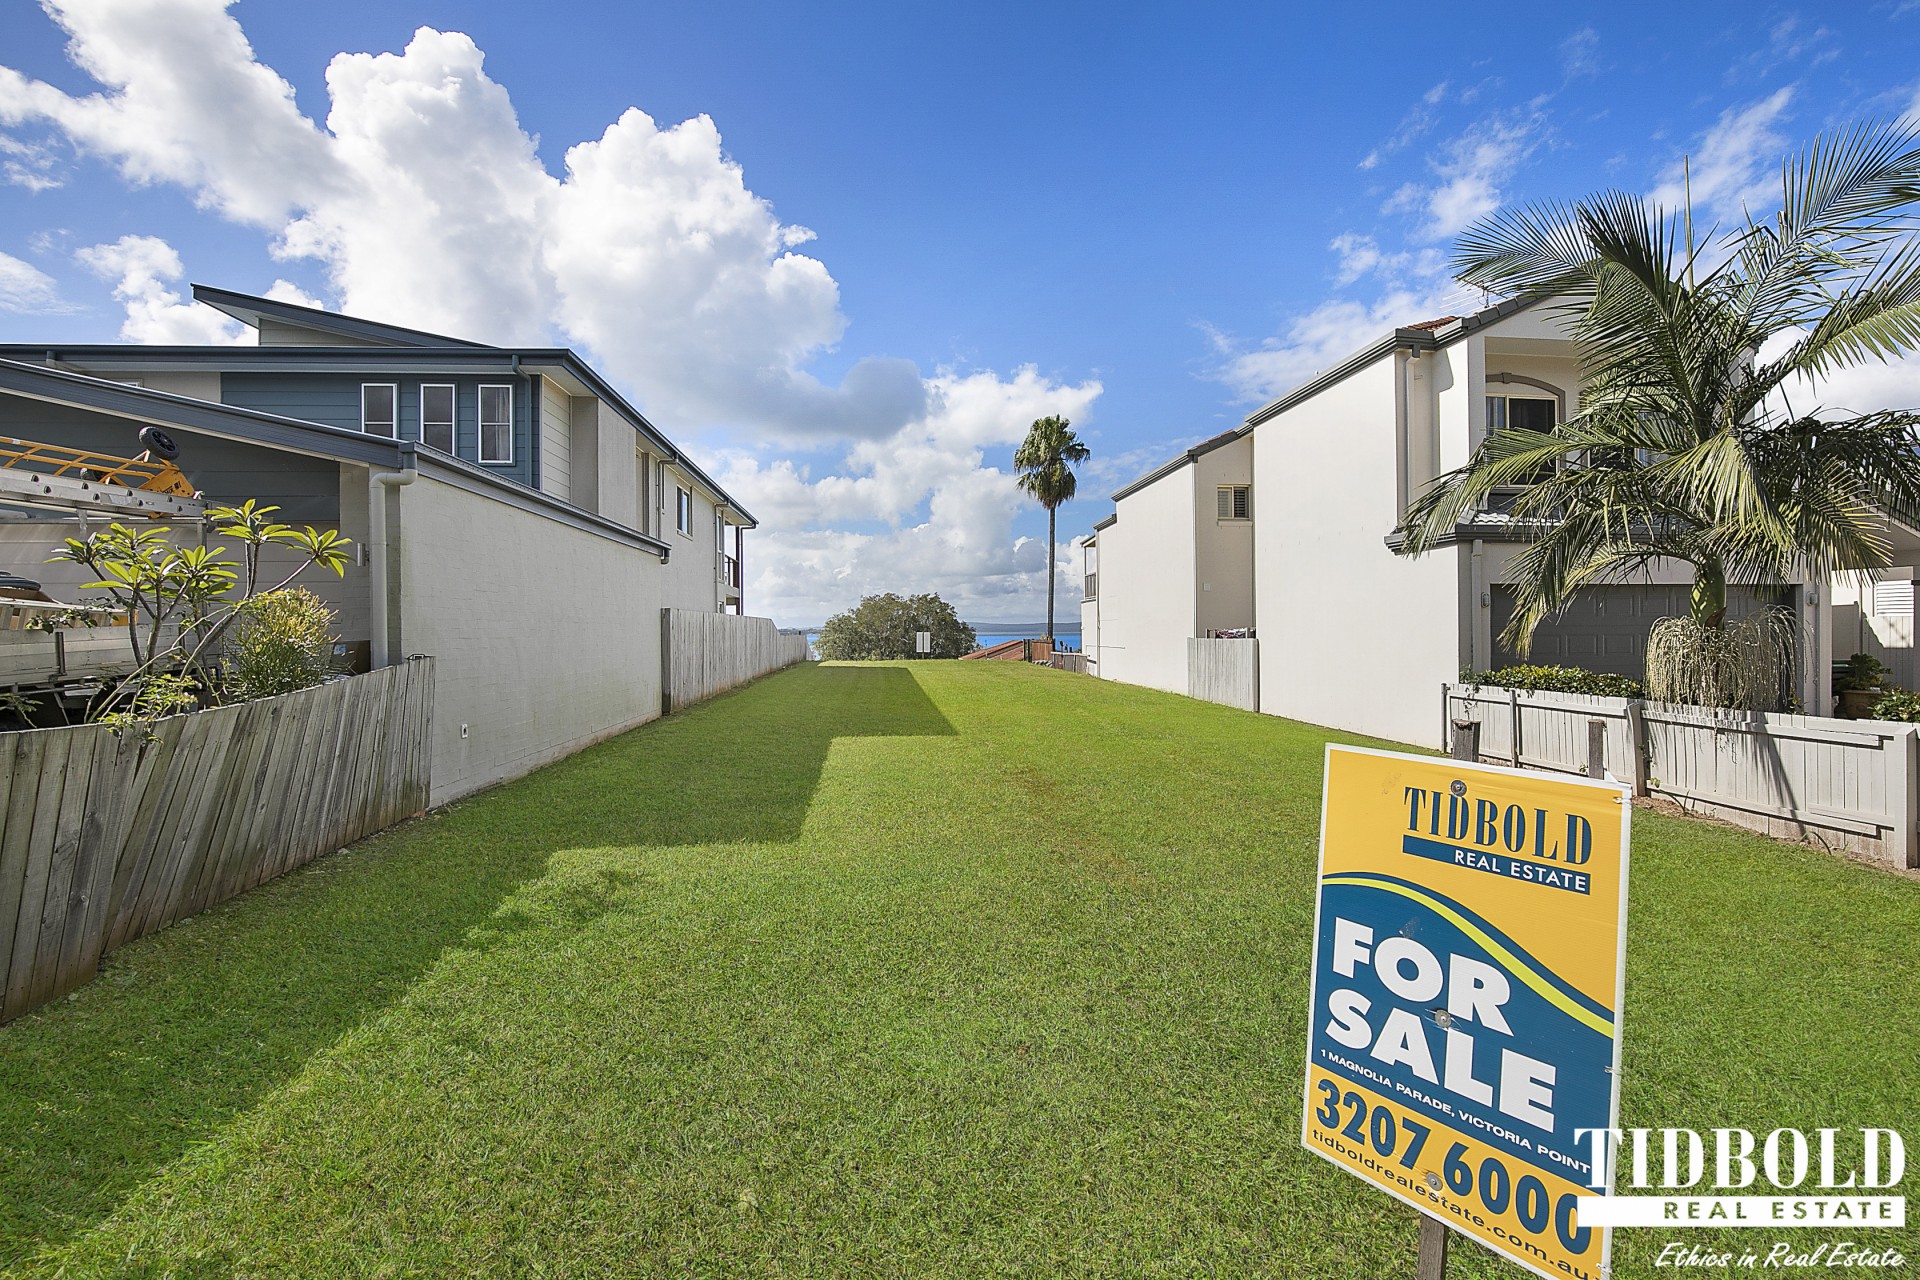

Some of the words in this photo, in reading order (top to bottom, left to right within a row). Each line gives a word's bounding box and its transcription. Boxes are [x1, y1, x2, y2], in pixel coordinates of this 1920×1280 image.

[1404, 787, 1592, 865] TIDBOLD
[1454, 849, 1501, 873] REAL
[1510, 861, 1587, 892] ESTATE
[1332, 916, 1514, 1037] FOR
[1320, 1049, 1327, 1058] 1
[1328, 1052, 1392, 1088] MAGNOLIA
[1396, 1082, 1456, 1118] PARADE,
[1458, 1109, 1532, 1151] VICTORIA
[1537, 1144, 1591, 1174] POINT
[1325, 988, 1556, 1133] SALE
[1312, 1128, 1588, 1280] tidboldrealestate.com.au
[1316, 1078, 1431, 1171] 3207
[1443, 1141, 1592, 1255] 6000
